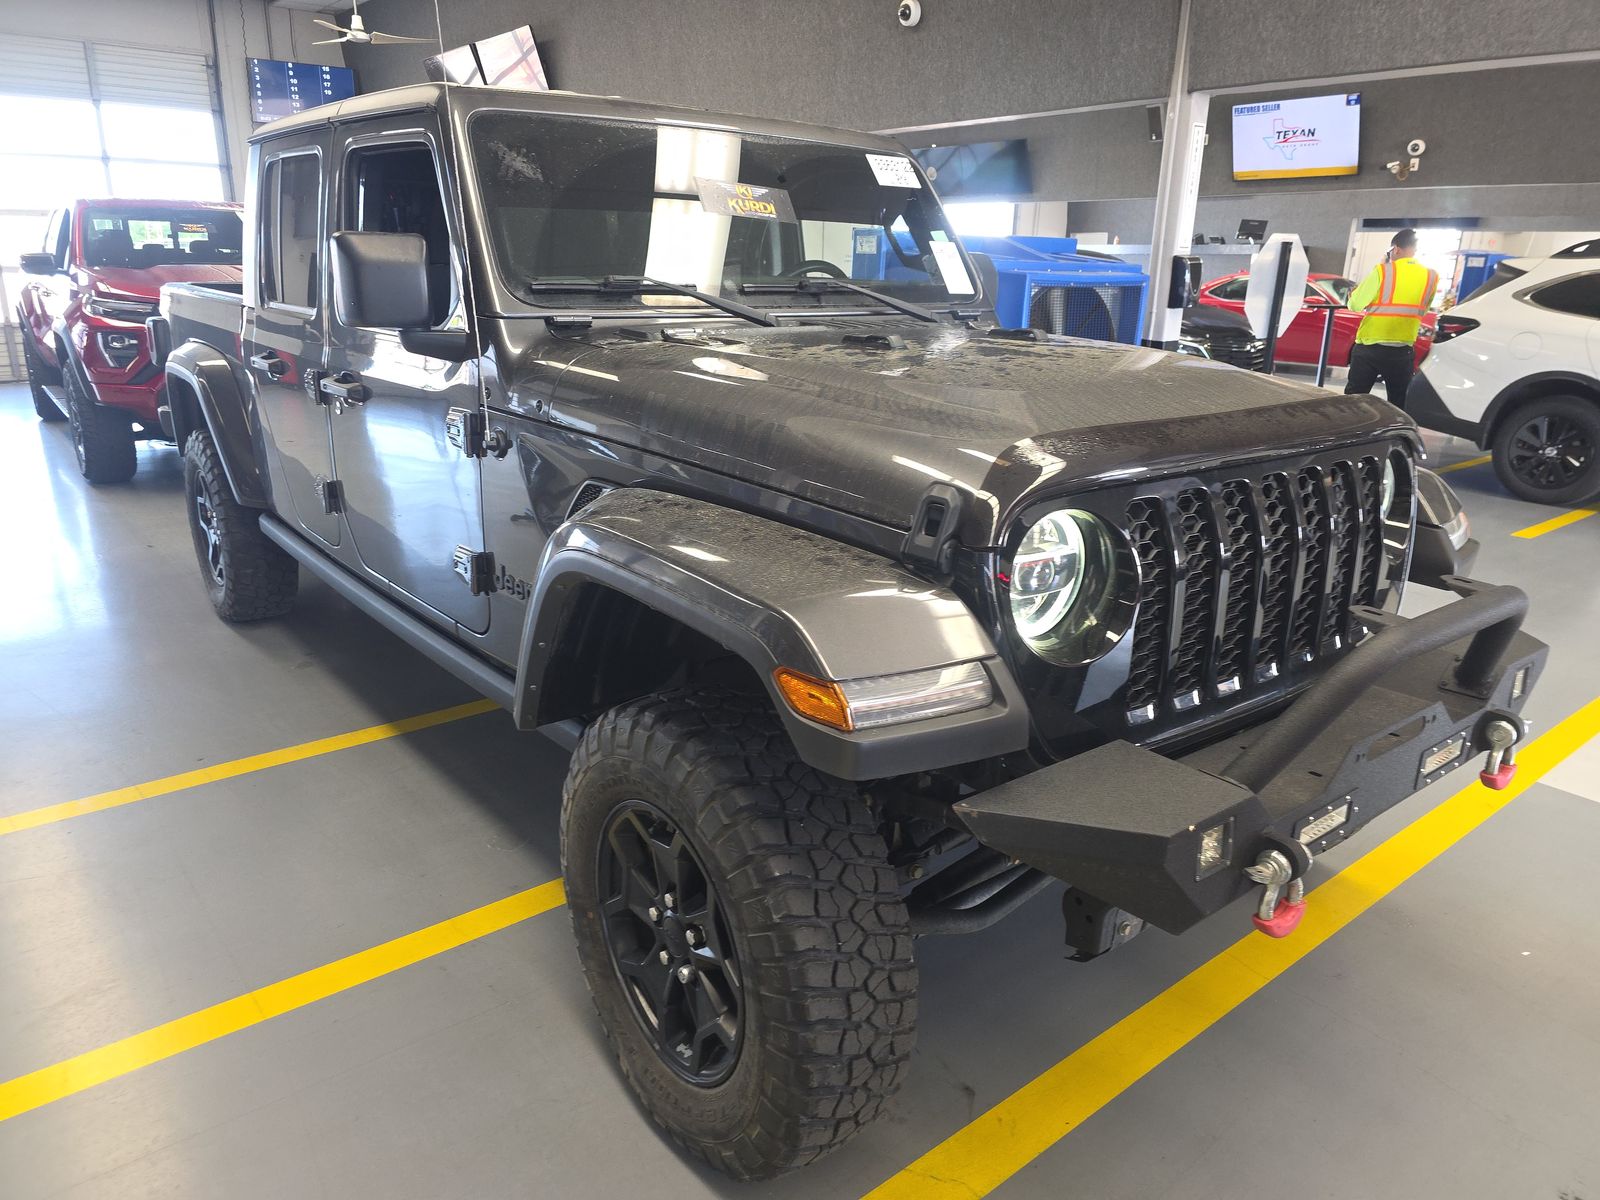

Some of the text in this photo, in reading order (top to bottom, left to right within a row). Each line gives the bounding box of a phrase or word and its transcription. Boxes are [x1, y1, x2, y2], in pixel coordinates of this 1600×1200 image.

[1234, 103, 1281, 115] FEATURED SELLER
[1275, 127, 1317, 140] TEXAN
[727, 198, 777, 215] KURDI
